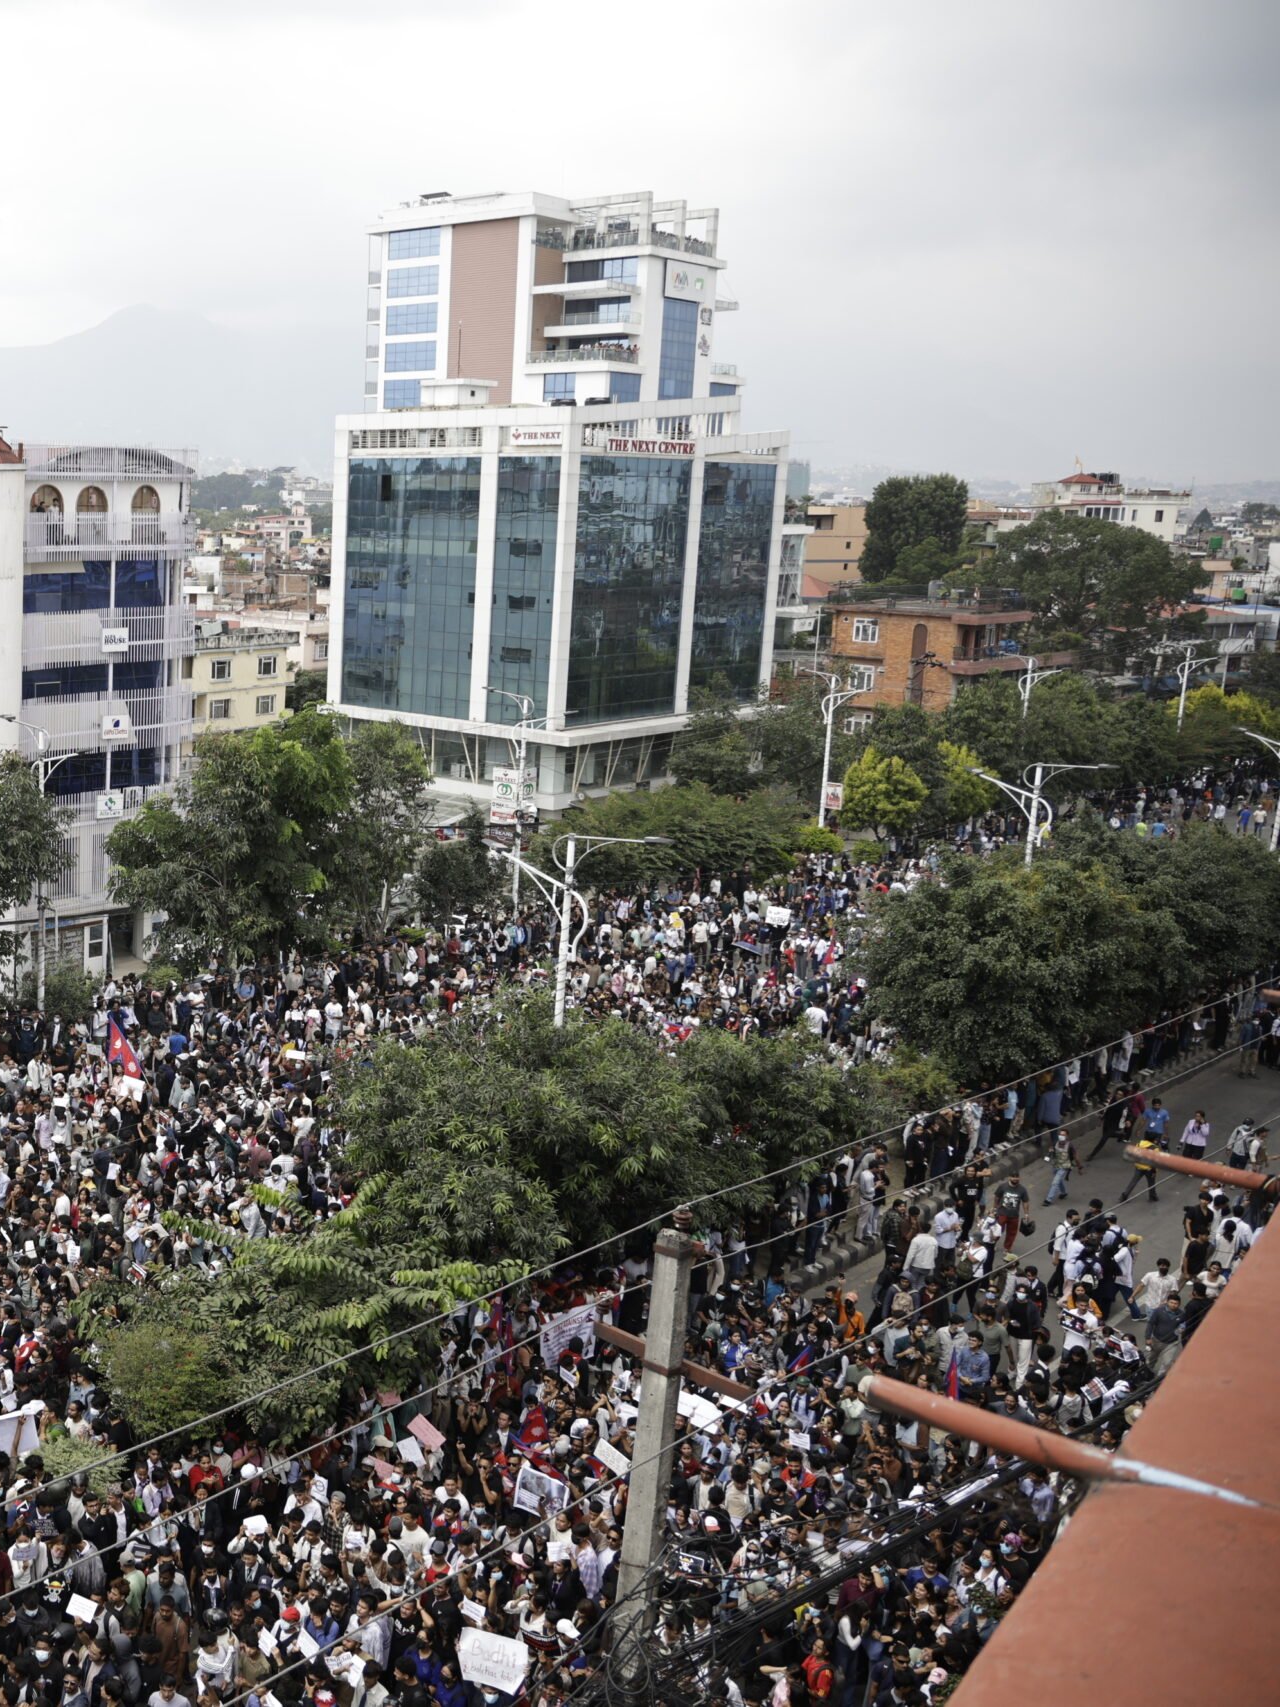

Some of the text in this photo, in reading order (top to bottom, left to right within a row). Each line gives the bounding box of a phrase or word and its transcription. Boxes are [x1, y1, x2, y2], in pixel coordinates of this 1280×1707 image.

[523, 431, 561, 440] THE NEXT
[608, 439, 696, 455] THE NEXT CENTRE
